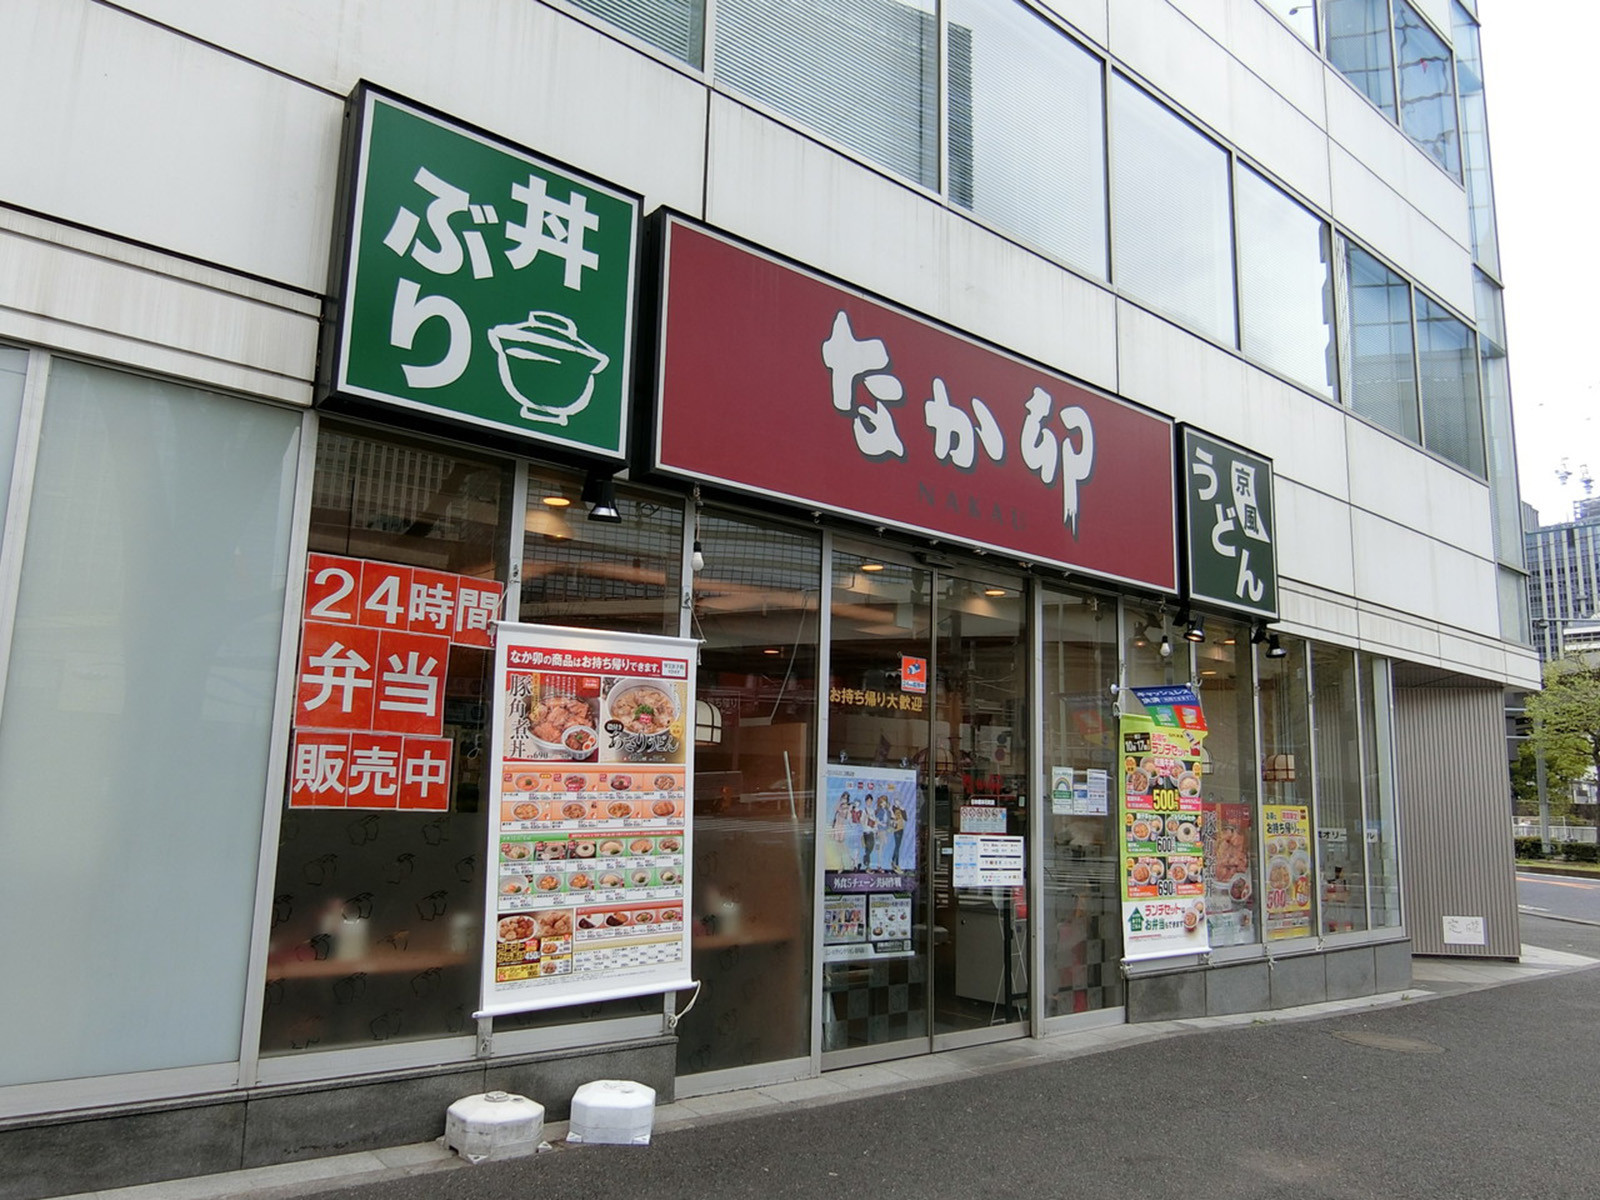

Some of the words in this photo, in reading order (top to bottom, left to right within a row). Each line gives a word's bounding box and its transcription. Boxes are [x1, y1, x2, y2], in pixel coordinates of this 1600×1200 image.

[822, 310, 1095, 536] なか卯
[917, 481, 1028, 531] NAKAU
[1191, 446, 1265, 602] うどん
[1233, 465, 1261, 536] 京風
[309, 567, 500, 632] 24時間
[301, 641, 439, 717] 弁当
[829, 686, 923, 713] お持ち帰り大歓迎
[508, 673, 532, 759] 豚角煮丼
[293, 744, 448, 798] 販売中
[1151, 742, 1190, 757] ランチセット
[833, 876, 902, 889] 外食5チェーン共同作戦
